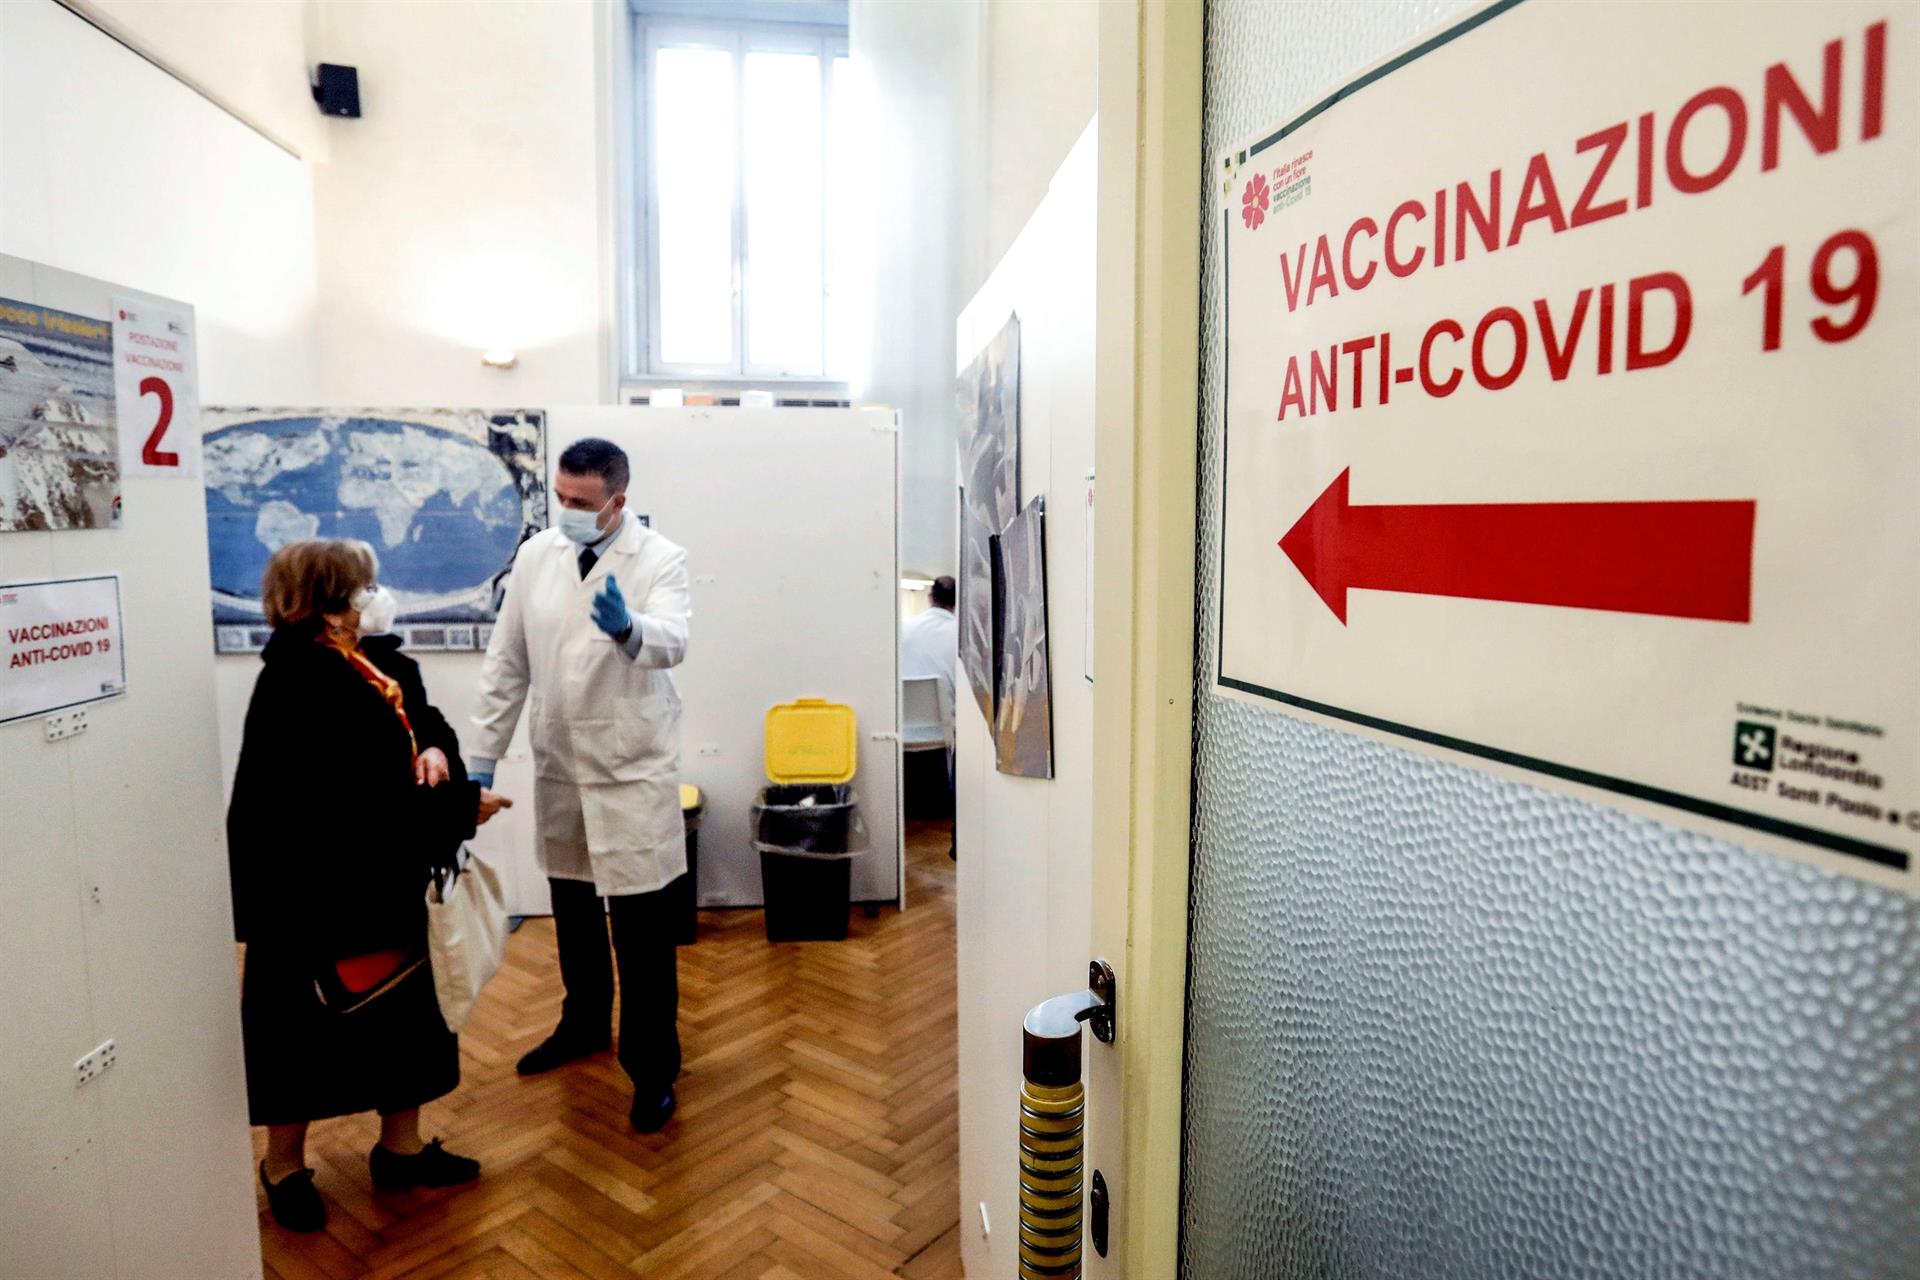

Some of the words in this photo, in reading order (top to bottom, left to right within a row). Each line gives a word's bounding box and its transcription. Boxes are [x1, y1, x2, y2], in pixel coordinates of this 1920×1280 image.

[1279, 20, 1888, 313] VACCINAZIONI
[1277, 270, 1693, 422] ANTI-COVID
[1740, 227, 1881, 353] 19
[128, 331, 178, 353] POSTAZIONE
[125, 352, 184, 374] VACCINAZIONE
[139, 376, 179, 467] 2
[9, 617, 109, 643] VACCINAZIONI
[9, 640, 93, 669] ANTI-COVID
[97, 639, 110, 652] 19
[1781, 735, 1859, 764] Regione
[1779, 754, 1883, 790] Lombardia
